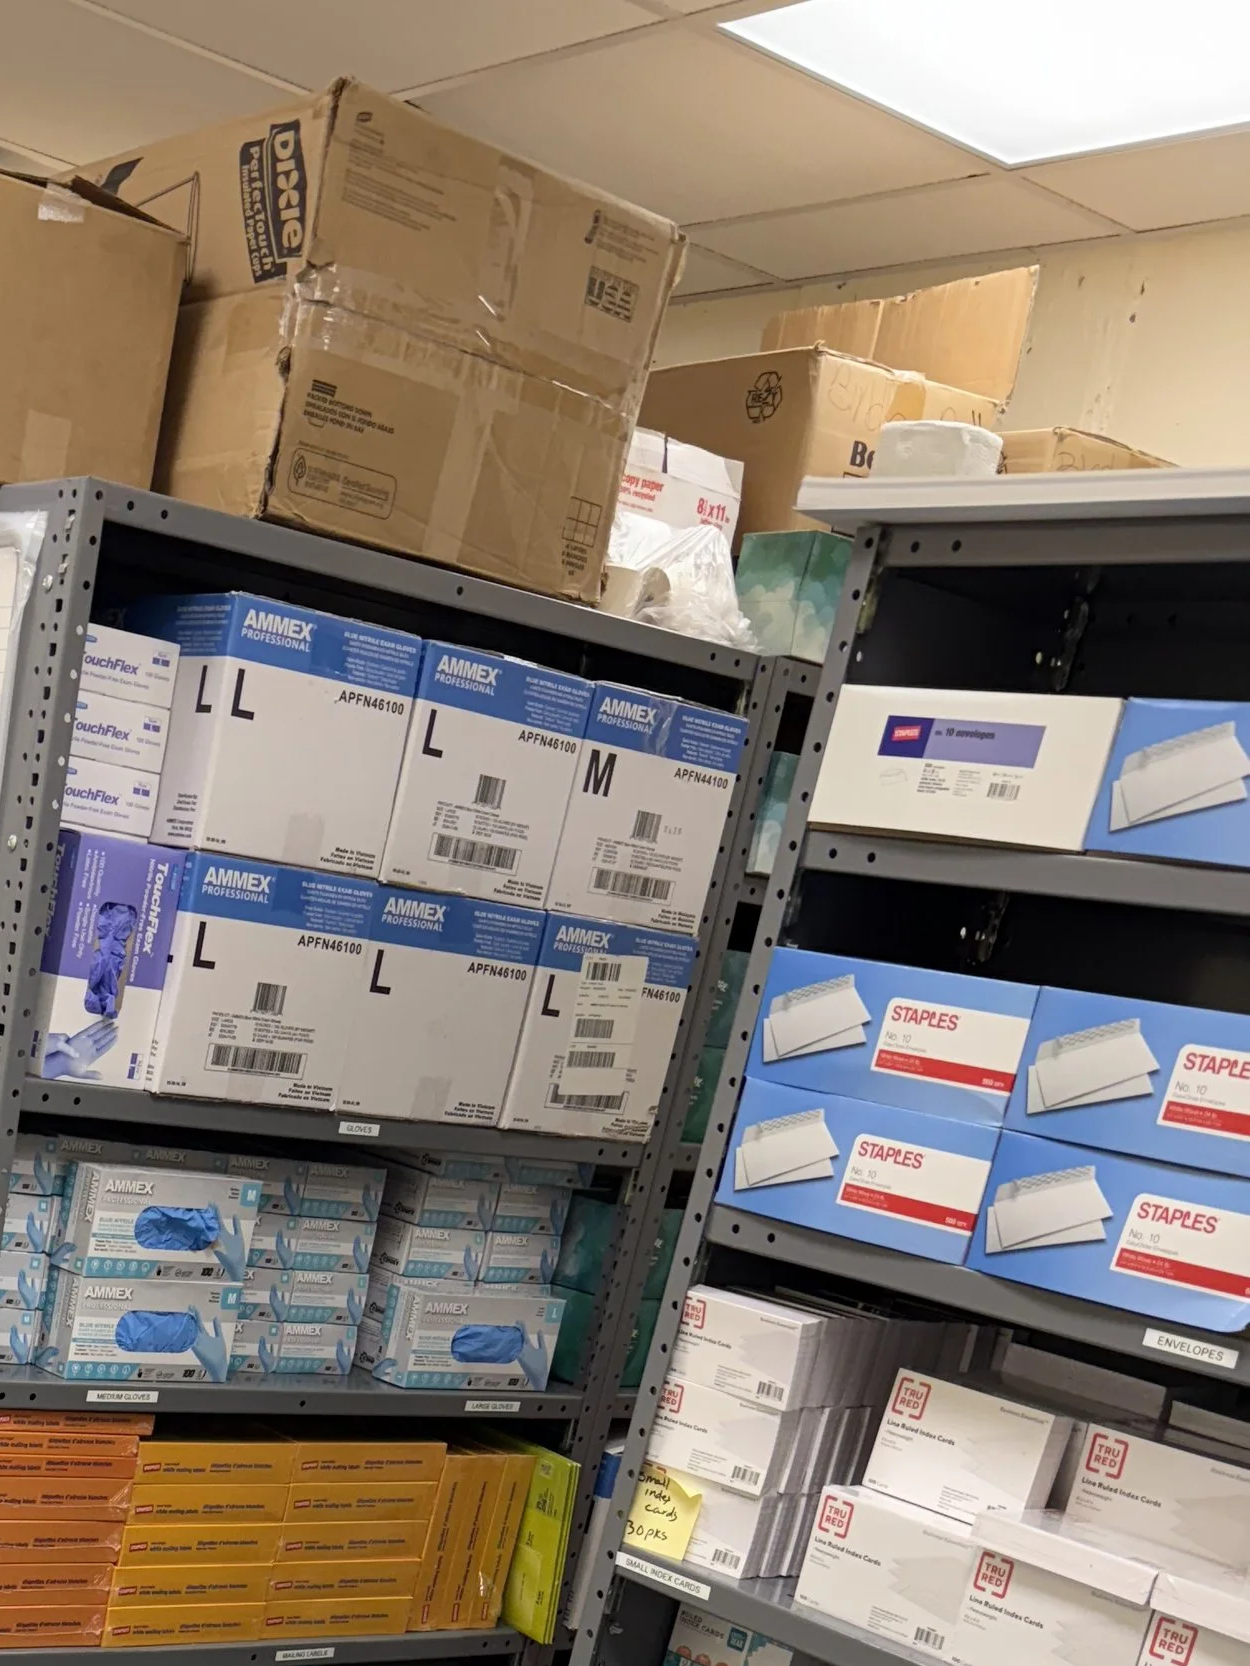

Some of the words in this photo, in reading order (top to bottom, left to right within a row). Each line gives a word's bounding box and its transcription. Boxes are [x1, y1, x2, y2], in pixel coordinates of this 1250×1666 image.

[641, 479, 665, 492] paper
[243, 608, 314, 639] AMMEX
[241, 628, 310, 653] PROFESSIONAL
[436, 654, 498, 686] AMMEX
[195, 665, 212, 713] L
[231, 668, 254, 721] L
[434, 672, 494, 696] PROFESSIONAL
[338, 689, 404, 716] APFN46100
[599, 697, 656, 725] AMMEX
[422, 708, 443, 758] L
[597, 714, 653, 734] PROFESSIONAL
[518, 729, 577, 754] APFN46100
[582, 749, 617, 798] M
[674, 767, 728, 790] APFN44100
[204, 866, 272, 894] AMMEX
[202, 884, 269, 904] PROFESSIONAL
[139, 860, 171, 954] TouchFlex
[384, 897, 447, 921] AMMEX
[382, 914, 443, 932] PROFESSIONAL
[192, 921, 215, 969] L
[298, 934, 362, 955] APFN46100
[556, 925, 610, 949] AMMEX
[369, 949, 391, 995] L
[468, 962, 527, 982] APFN46100
[541, 974, 560, 1017] L
[641, 987, 681, 1004] FN46100
[891, 1005, 959, 1031] STAPLES
[902, 1034, 912, 1043] 10
[1183, 1052, 1250, 1080] STAPLE
[857, 1141, 924, 1170] STAPLES
[868, 1170, 877, 1179] 10
[105, 1179, 154, 1195] AMMEX
[1136, 1201, 1218, 1234] STAPLES
[85, 1286, 134, 1300] AMMEX
[1157, 1335, 1225, 1362] ENVELOPES
[899, 1396, 920, 1410] RED
[903, 1387, 923, 1401] TRU
[1093, 1453, 1117, 1469] RED
[1097, 1443, 1121, 1459] TRU
[1080, 1476, 1097, 1487] Line
[1096, 1481, 1118, 1494] Ruled
[1118, 1488, 1139, 1500] Index
[1139, 1495, 1162, 1507] Cards
[824, 1514, 845, 1529] RED
[827, 1505, 848, 1519] TRU
[626, 1558, 649, 1573] SMALL
[650, 1567, 672, 1583] INDEX
[674, 1577, 701, 1594] CARDS
[980, 1572, 1003, 1588] RED
[984, 1562, 1006, 1578] TRU
[1158, 1638, 1185, 1655] RED
[1162, 1627, 1189, 1645] TRU
